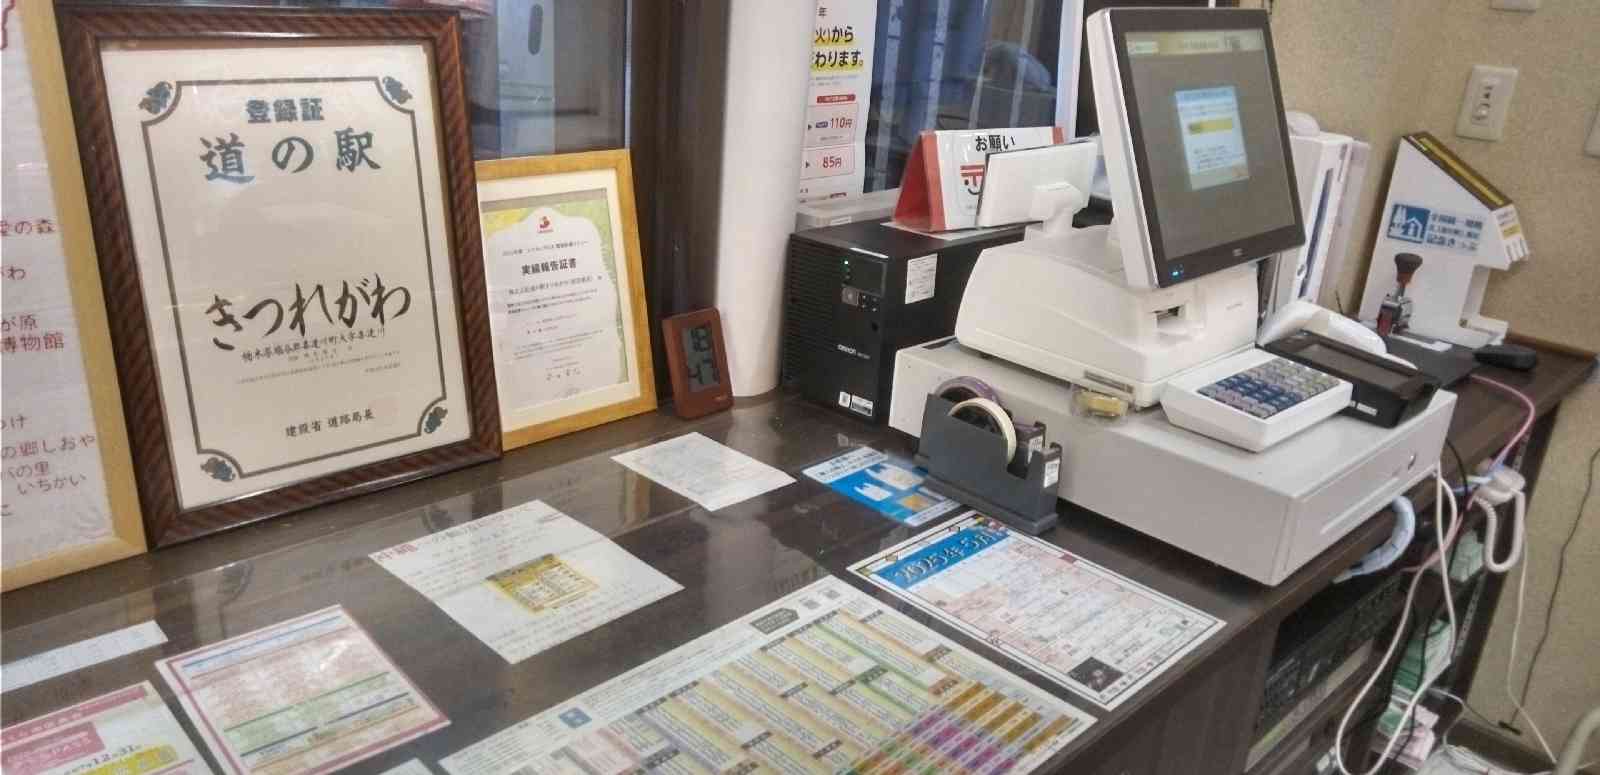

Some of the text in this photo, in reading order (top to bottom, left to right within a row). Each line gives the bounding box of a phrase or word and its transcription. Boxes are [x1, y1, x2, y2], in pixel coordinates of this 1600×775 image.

[814, 51, 864, 68] わります。
[246, 97, 325, 124] 登録証
[199, 125, 382, 183] 道の駅
[975, 134, 1017, 152] お願い
[521, 257, 577, 276] 実績報告証書
[205, 272, 412, 351] きつれがわ
[17, 474, 87, 496] いちかい
